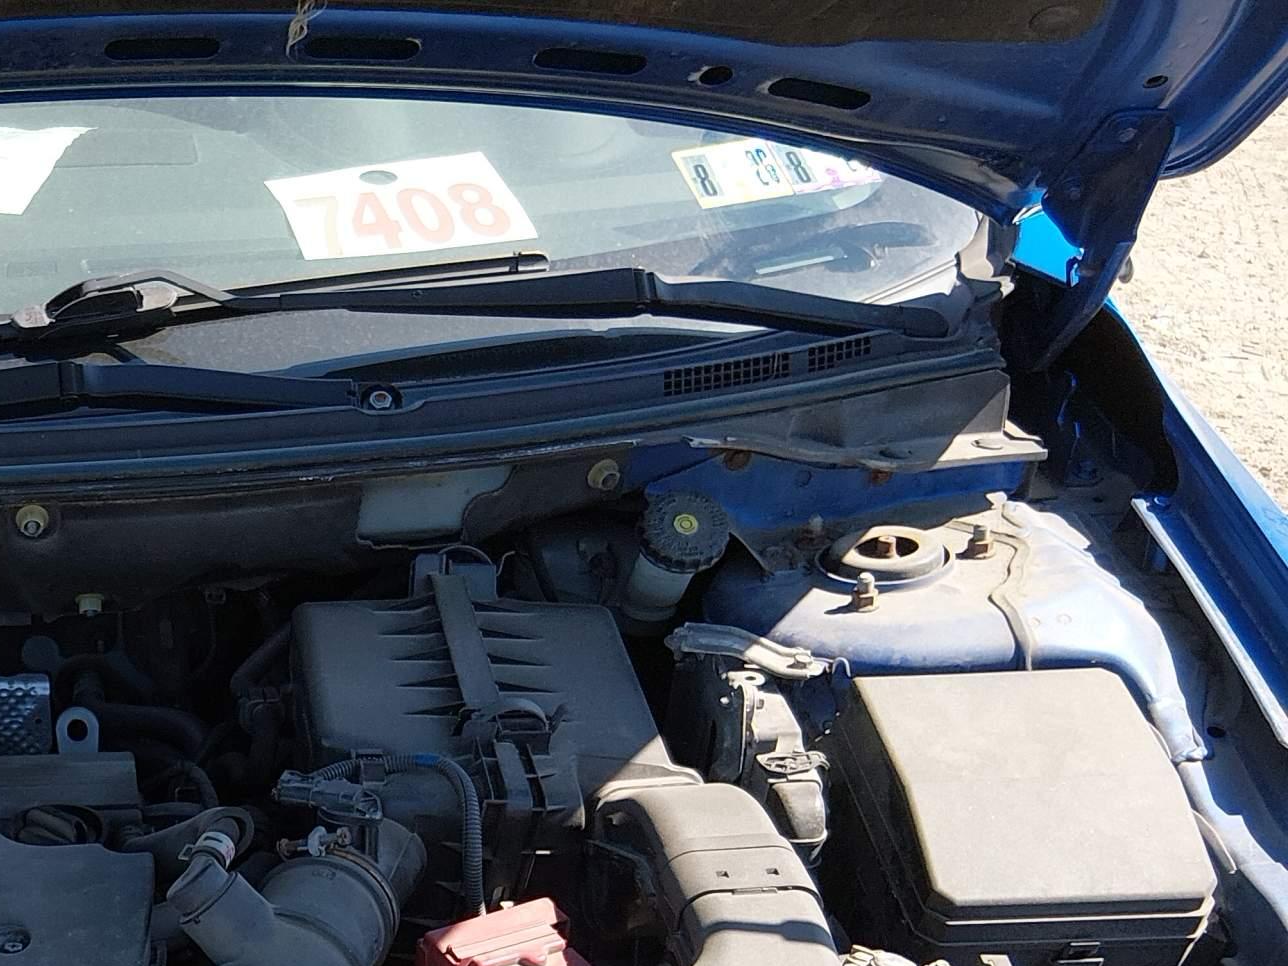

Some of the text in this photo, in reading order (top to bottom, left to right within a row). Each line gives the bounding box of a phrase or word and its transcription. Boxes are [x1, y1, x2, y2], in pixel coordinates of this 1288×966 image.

[693, 163, 719, 198] 8
[785, 150, 812, 184] 8
[292, 182, 513, 257] 7408
